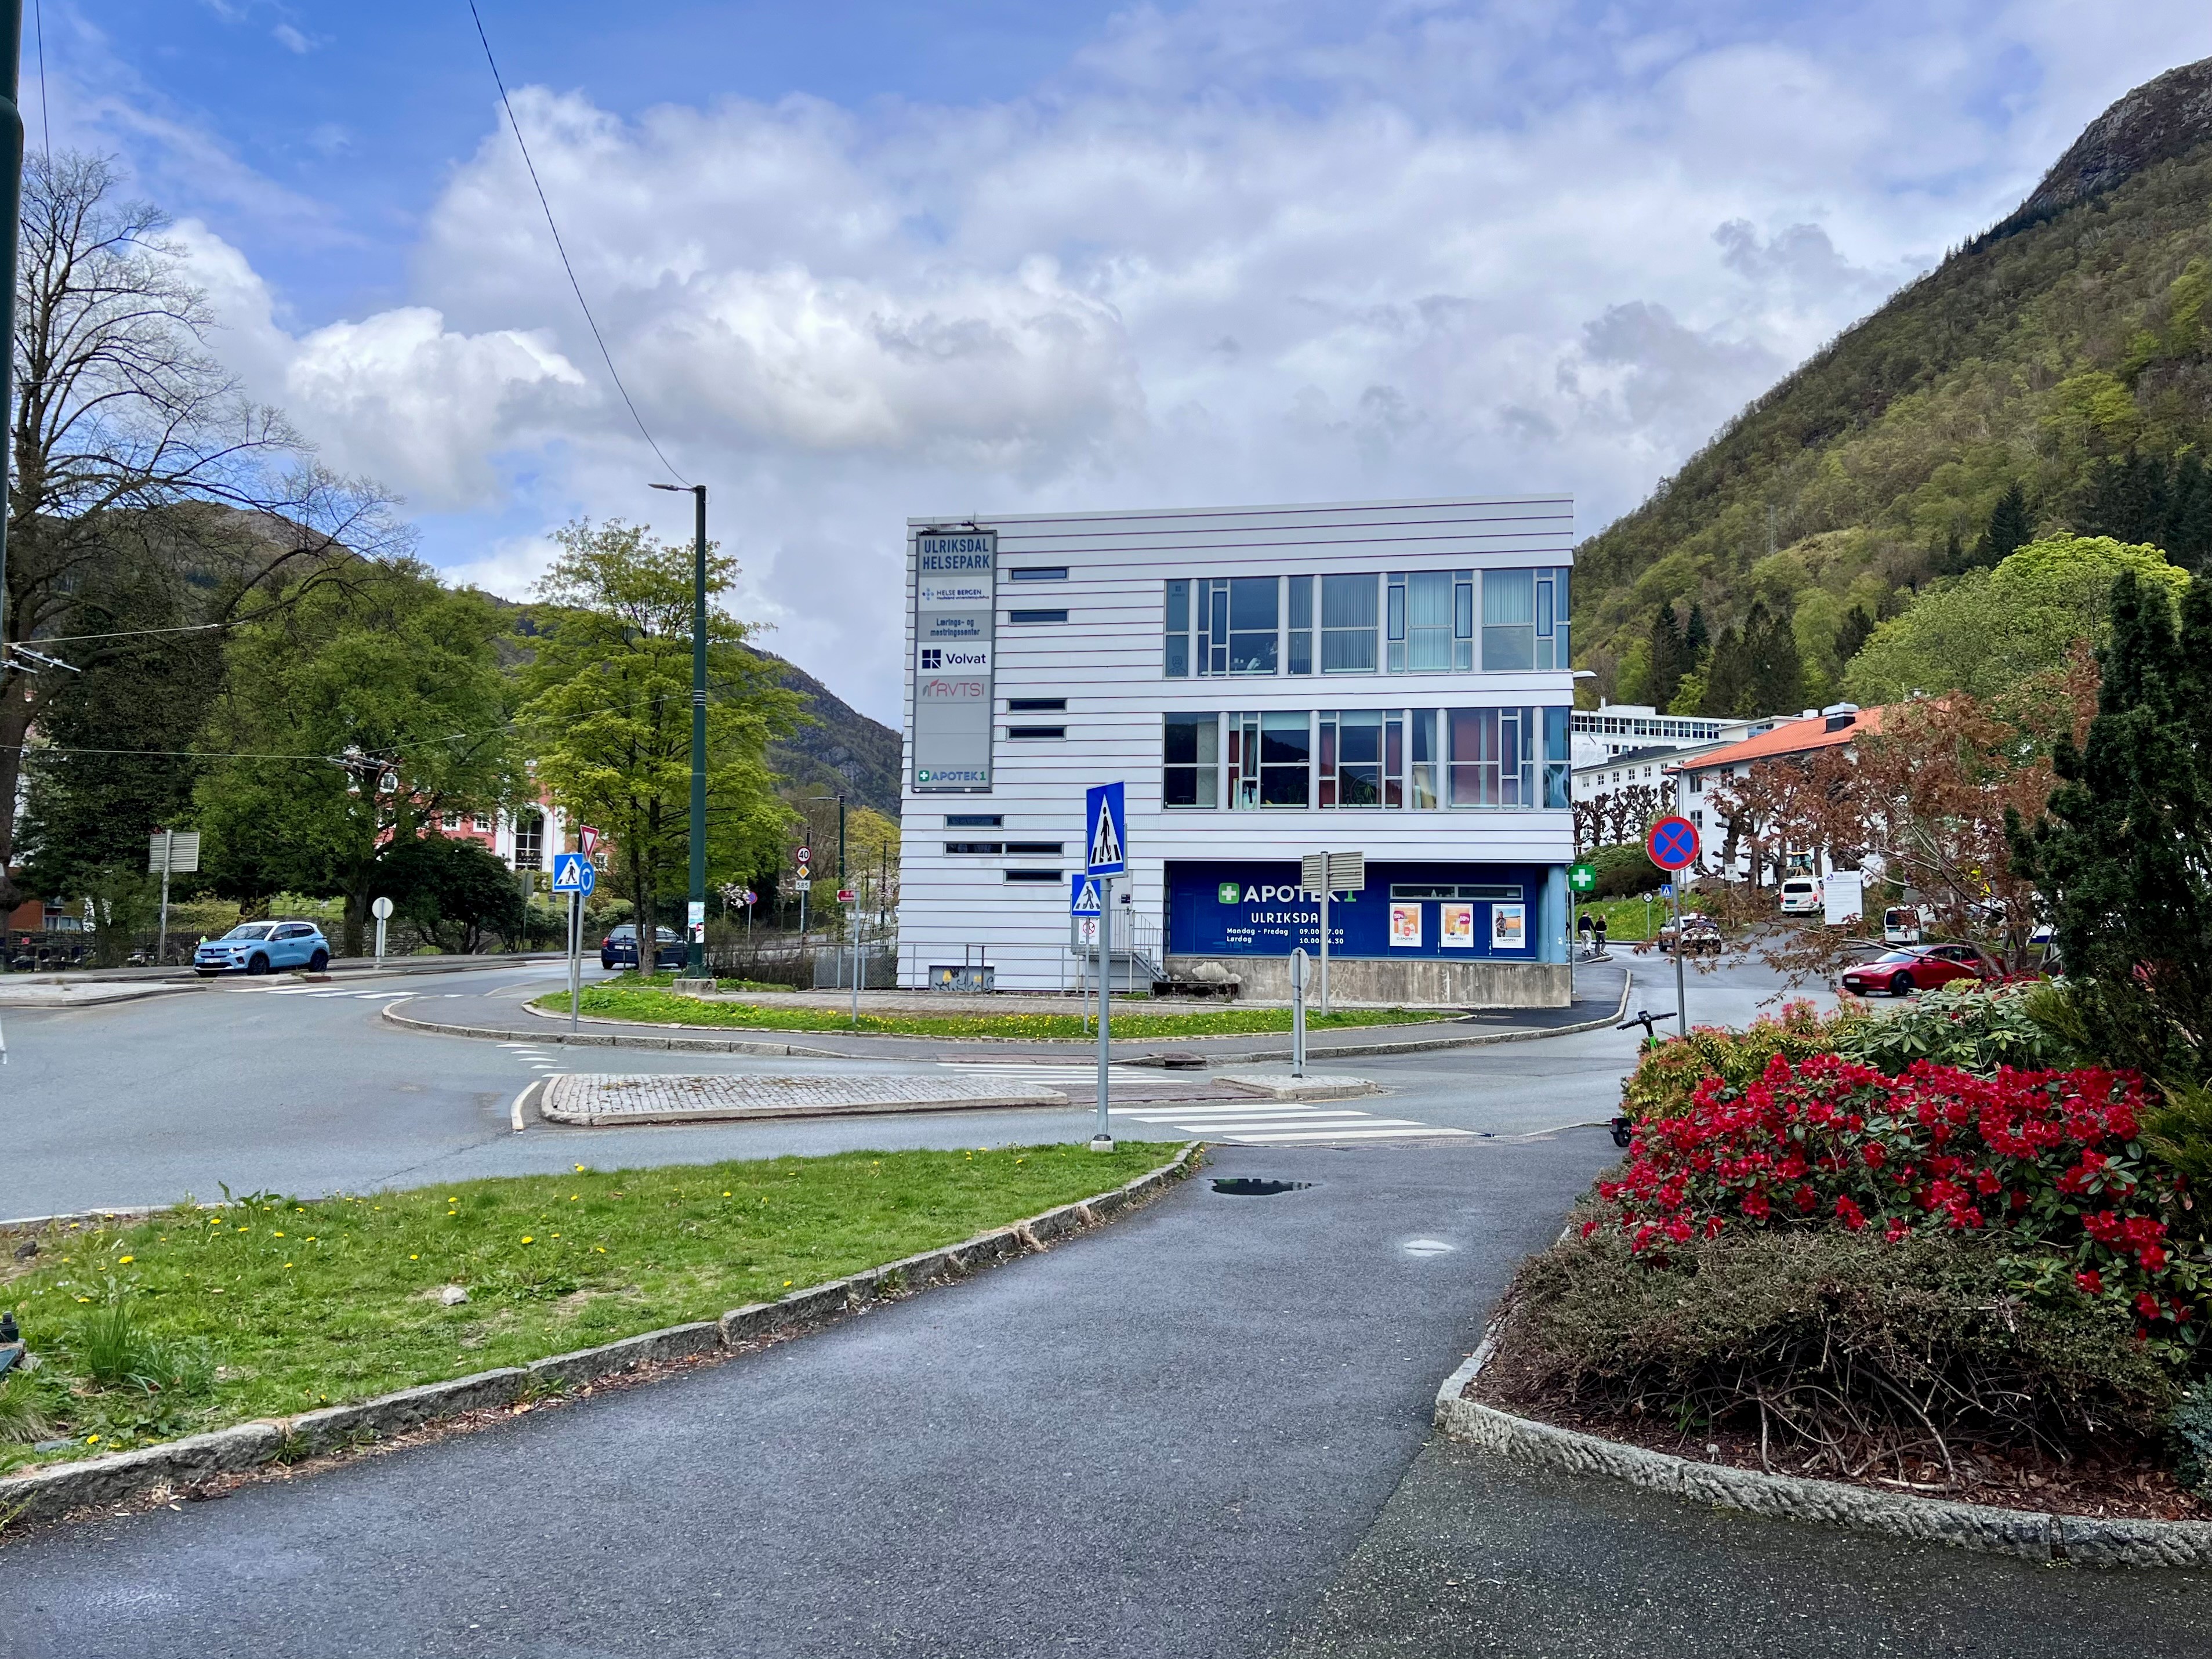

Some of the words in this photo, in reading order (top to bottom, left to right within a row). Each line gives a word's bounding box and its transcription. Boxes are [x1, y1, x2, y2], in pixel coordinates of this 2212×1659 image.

[924, 538, 989, 553] ULRIKSDAL
[923, 555, 990, 570] HELSEPARK
[937, 618, 964, 627] Lærings-
[930, 628, 980, 637] mestringssenter
[946, 653, 987, 664] Volvat
[936, 683, 984, 697] RVTSI
[931, 771, 978, 781] APOTEK
[980, 771, 986, 781] 1
[799, 850, 809, 859] 40
[1251, 912, 1318, 923] ULRIKSDA
[1227, 935, 1252, 943] Lørdag
